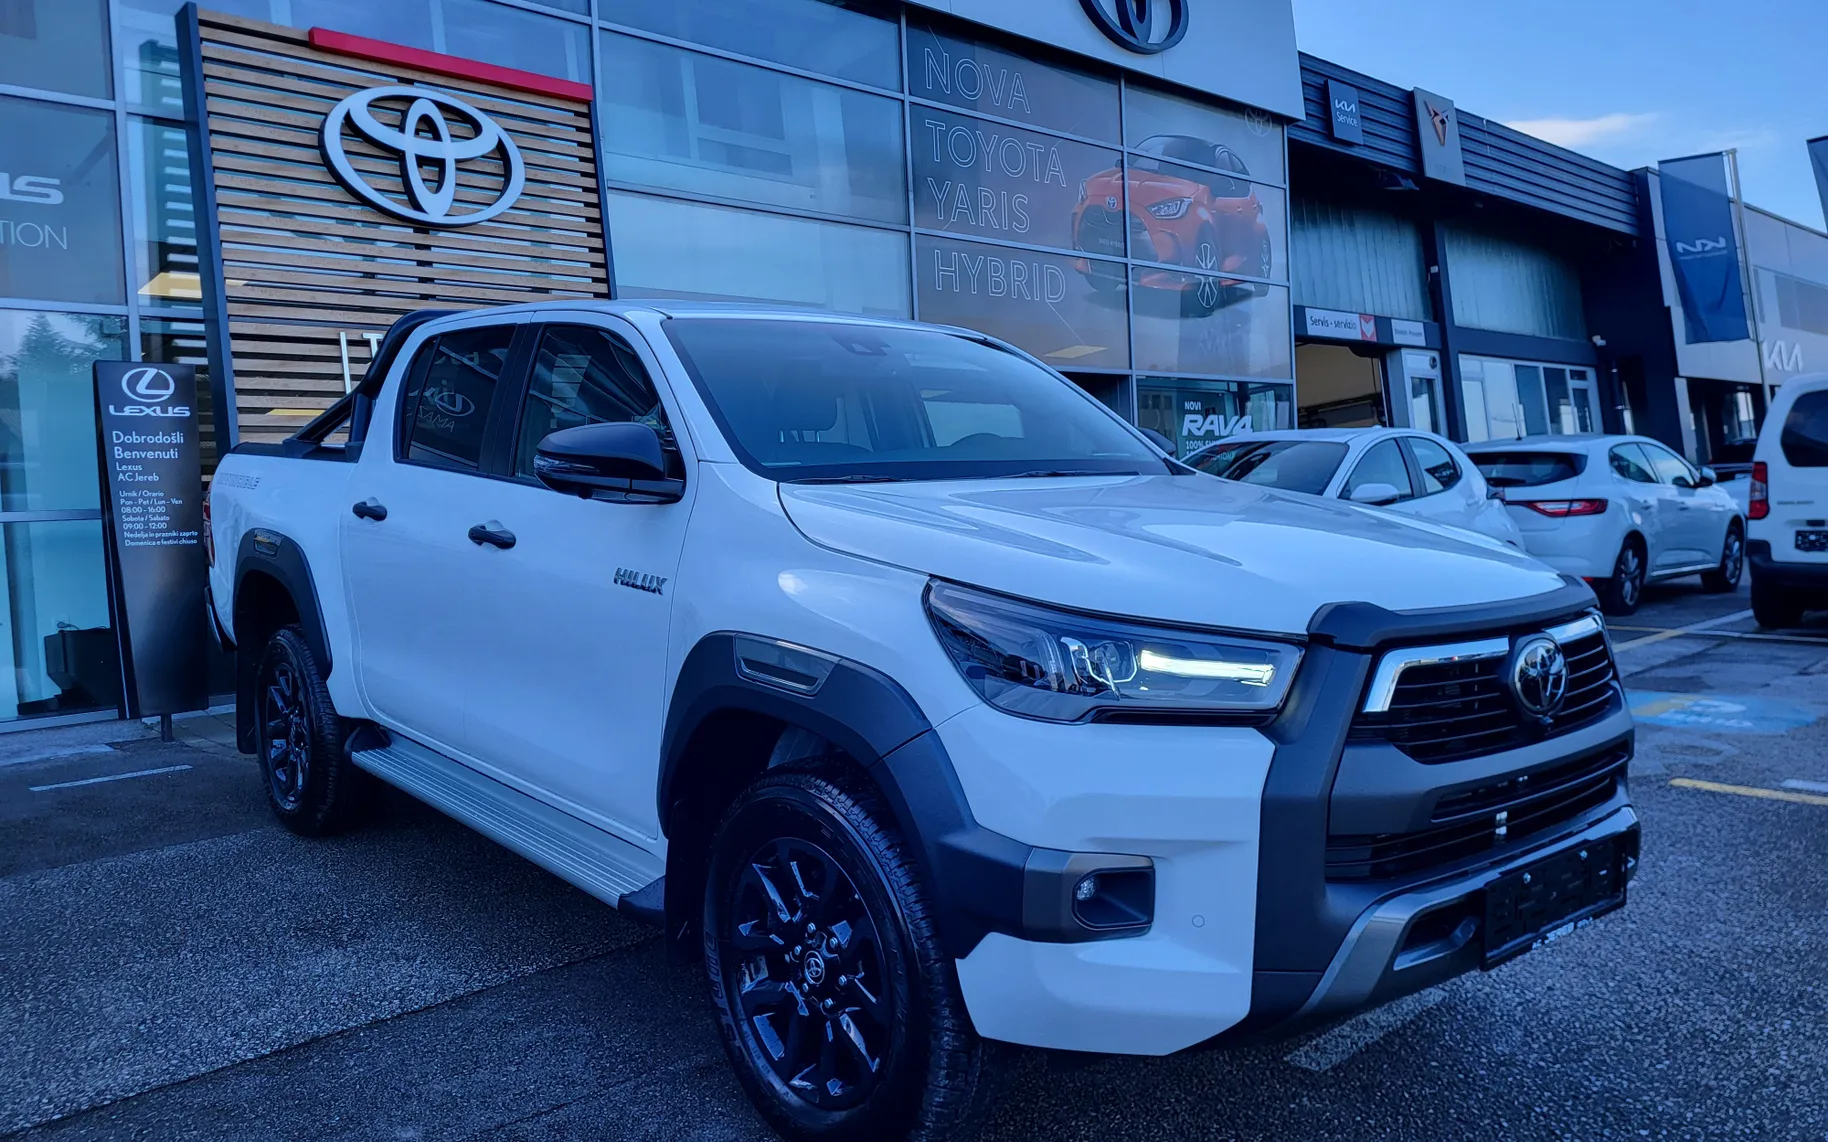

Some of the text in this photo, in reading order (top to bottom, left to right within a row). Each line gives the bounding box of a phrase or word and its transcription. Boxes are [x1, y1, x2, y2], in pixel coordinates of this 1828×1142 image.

[924, 48, 1031, 114] NOVA
[1336, 111, 1358, 127] Service
[925, 119, 1066, 187] TOYOTA
[0, 172, 64, 205] S
[927, 177, 1030, 233] YARIS
[934, 250, 1066, 303] HYBRID
[109, 405, 191, 417] LEXUS
[1184, 400, 1201, 411] NOVI
[1182, 414, 1253, 437] RAV4
[112, 430, 184, 444] Dobrodošli
[114, 446, 178, 458] Benvenuti
[116, 461, 143, 471] Lexus
[117, 473, 159, 481] AC Jereb
[119, 490, 137, 498] Urnik
[171, 497, 183, 505] Ven
[148, 505, 166, 513] 16:00
[122, 514, 144, 522] Sobota
[123, 522, 144, 530] 09:00
[613, 567, 668, 596] HILUX
